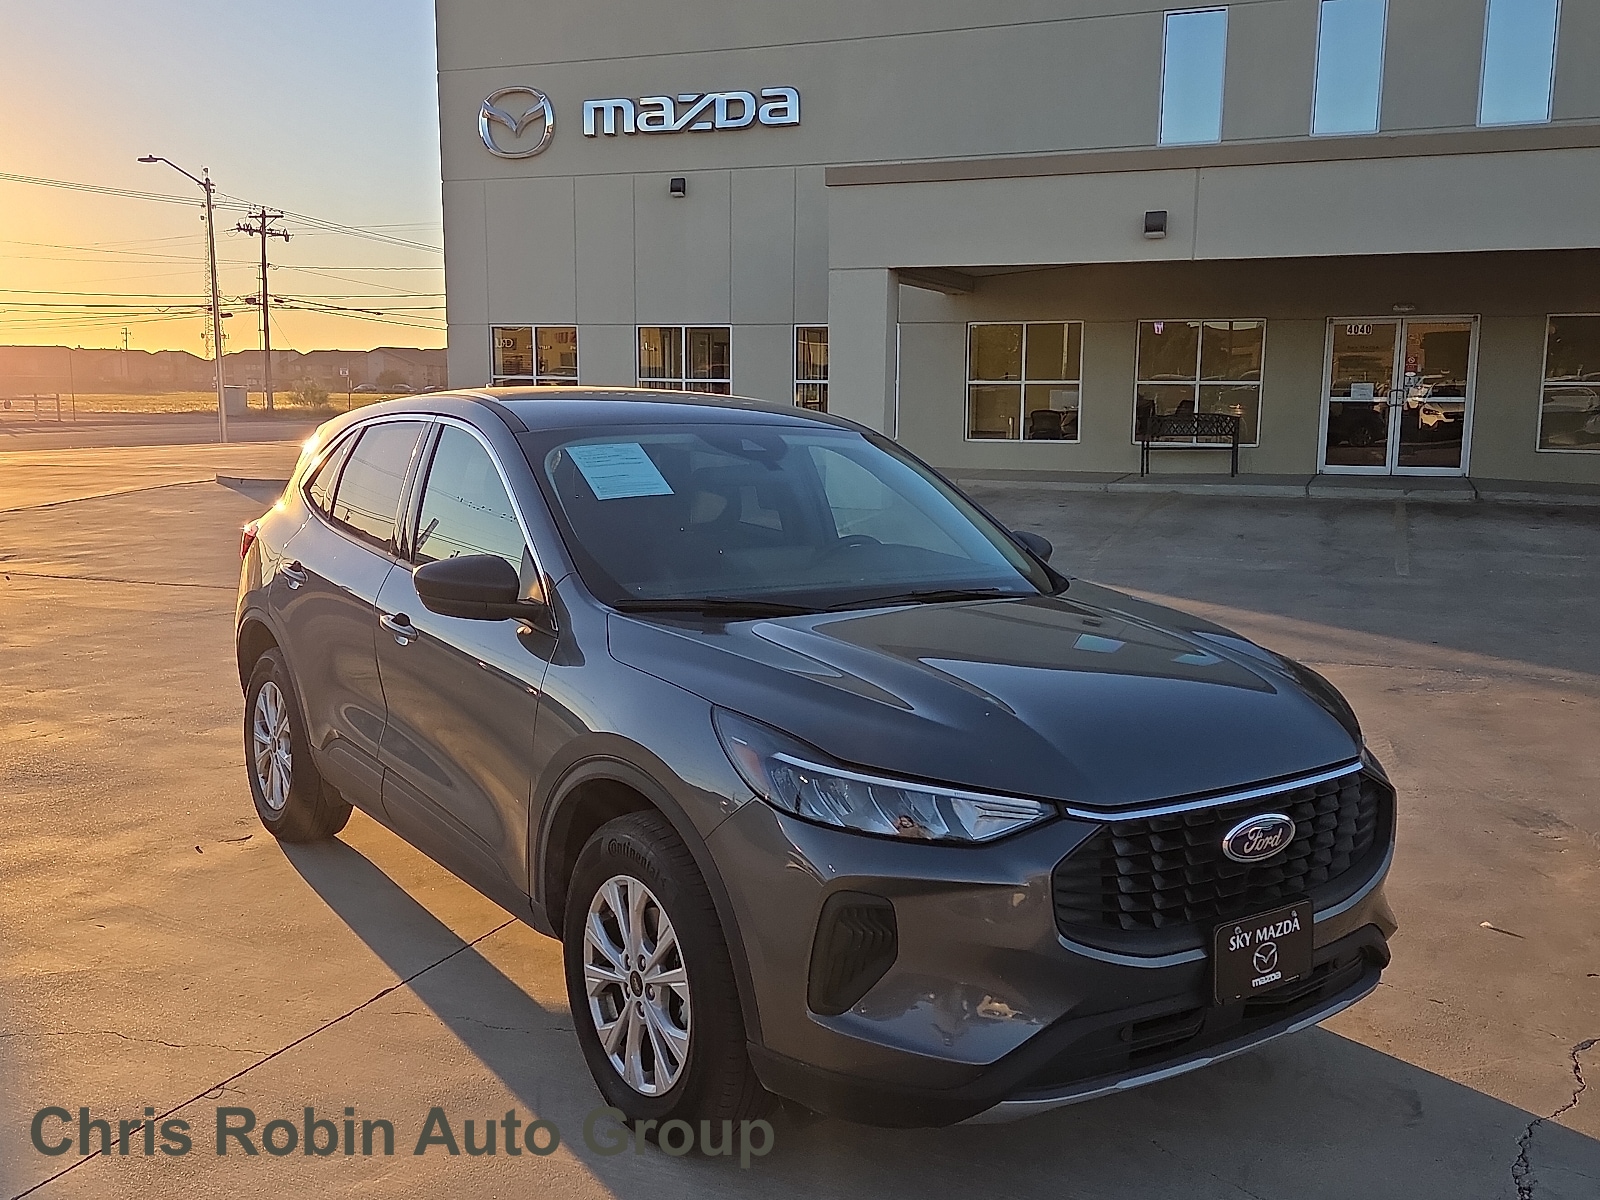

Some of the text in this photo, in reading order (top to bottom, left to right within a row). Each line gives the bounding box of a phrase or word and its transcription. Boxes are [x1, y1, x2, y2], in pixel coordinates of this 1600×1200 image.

[1347, 324, 1372, 334] 4040
[1243, 826, 1283, 853] Ford
[608, 838, 660, 880] Continental
[1229, 918, 1300, 951] SKY MAZDA
